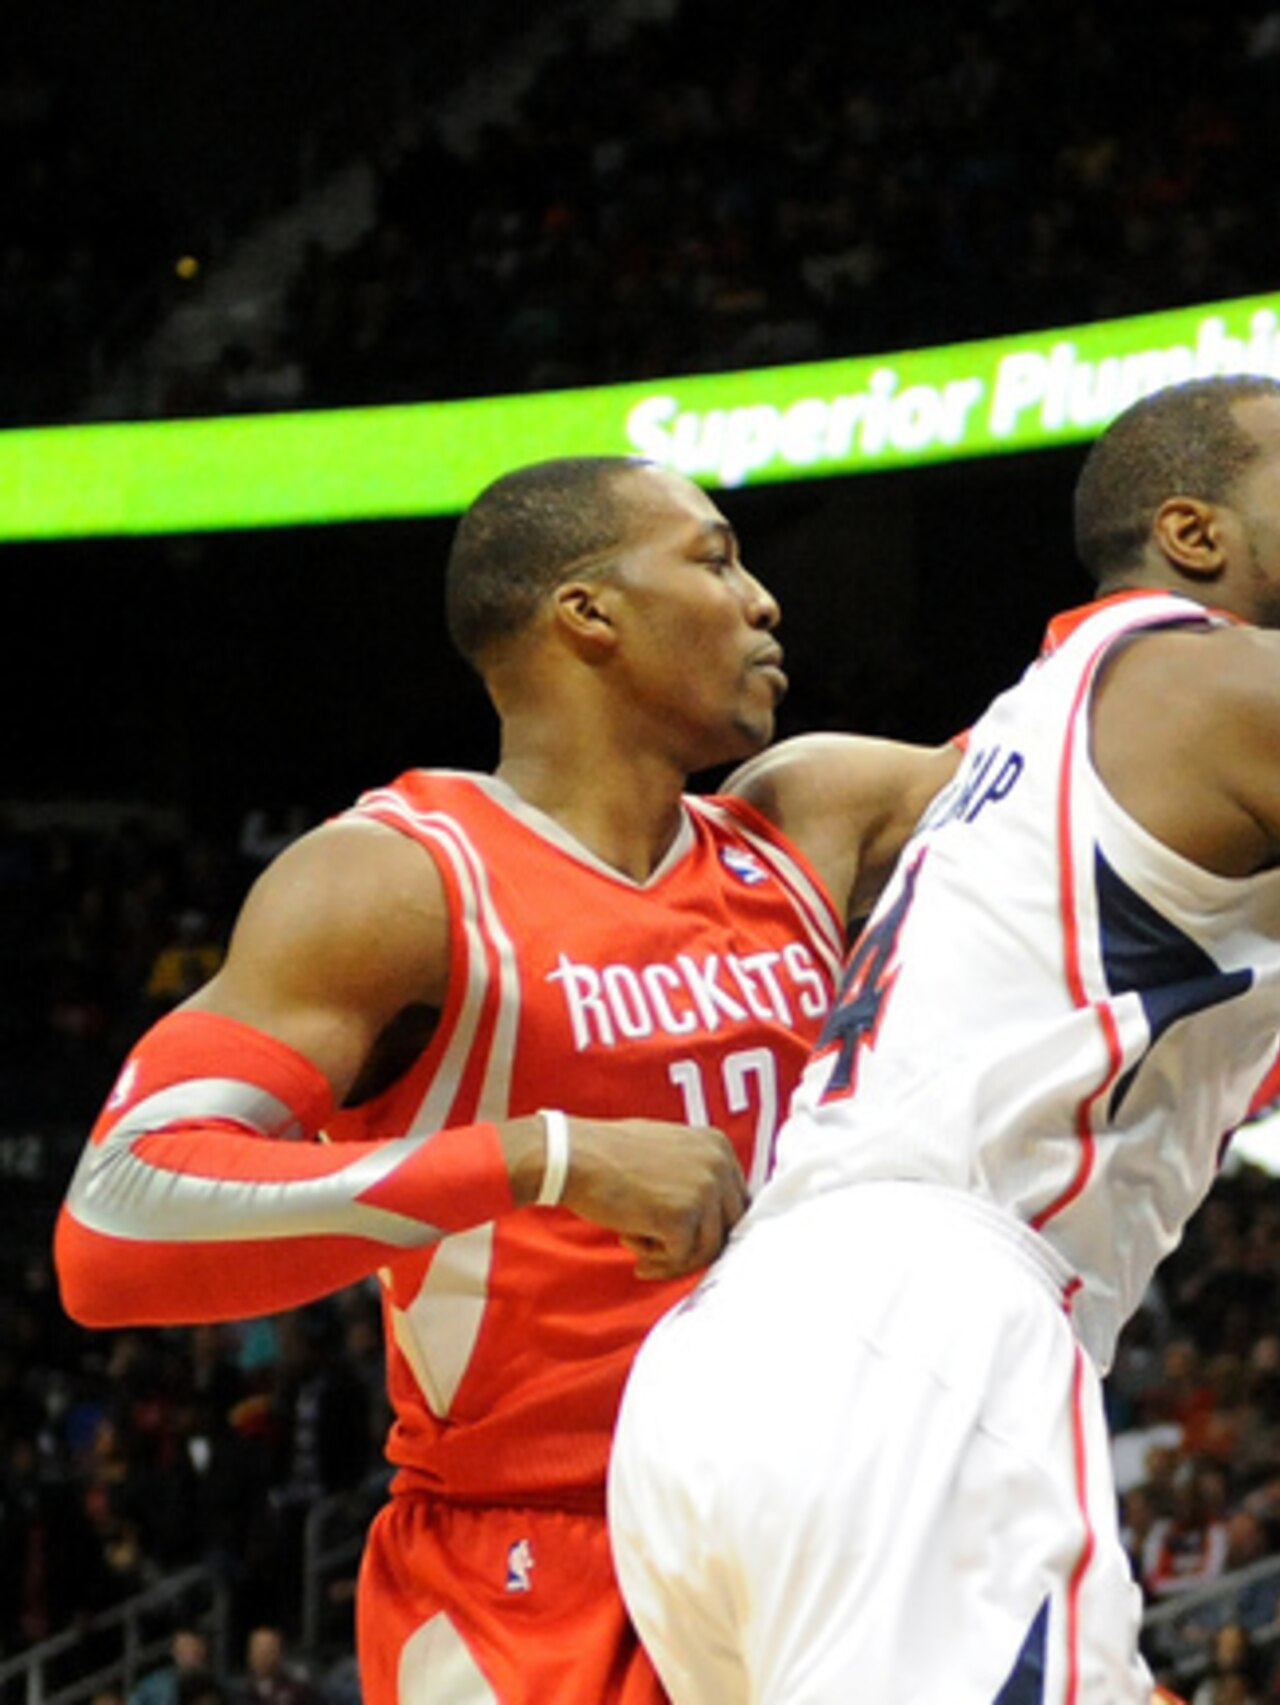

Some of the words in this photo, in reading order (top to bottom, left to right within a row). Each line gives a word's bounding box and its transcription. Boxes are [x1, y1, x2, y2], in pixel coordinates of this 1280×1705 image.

[627, 368, 984, 488] Superior
[545, 941, 829, 1053] ROCKETS
[811, 845, 928, 1107] 4
